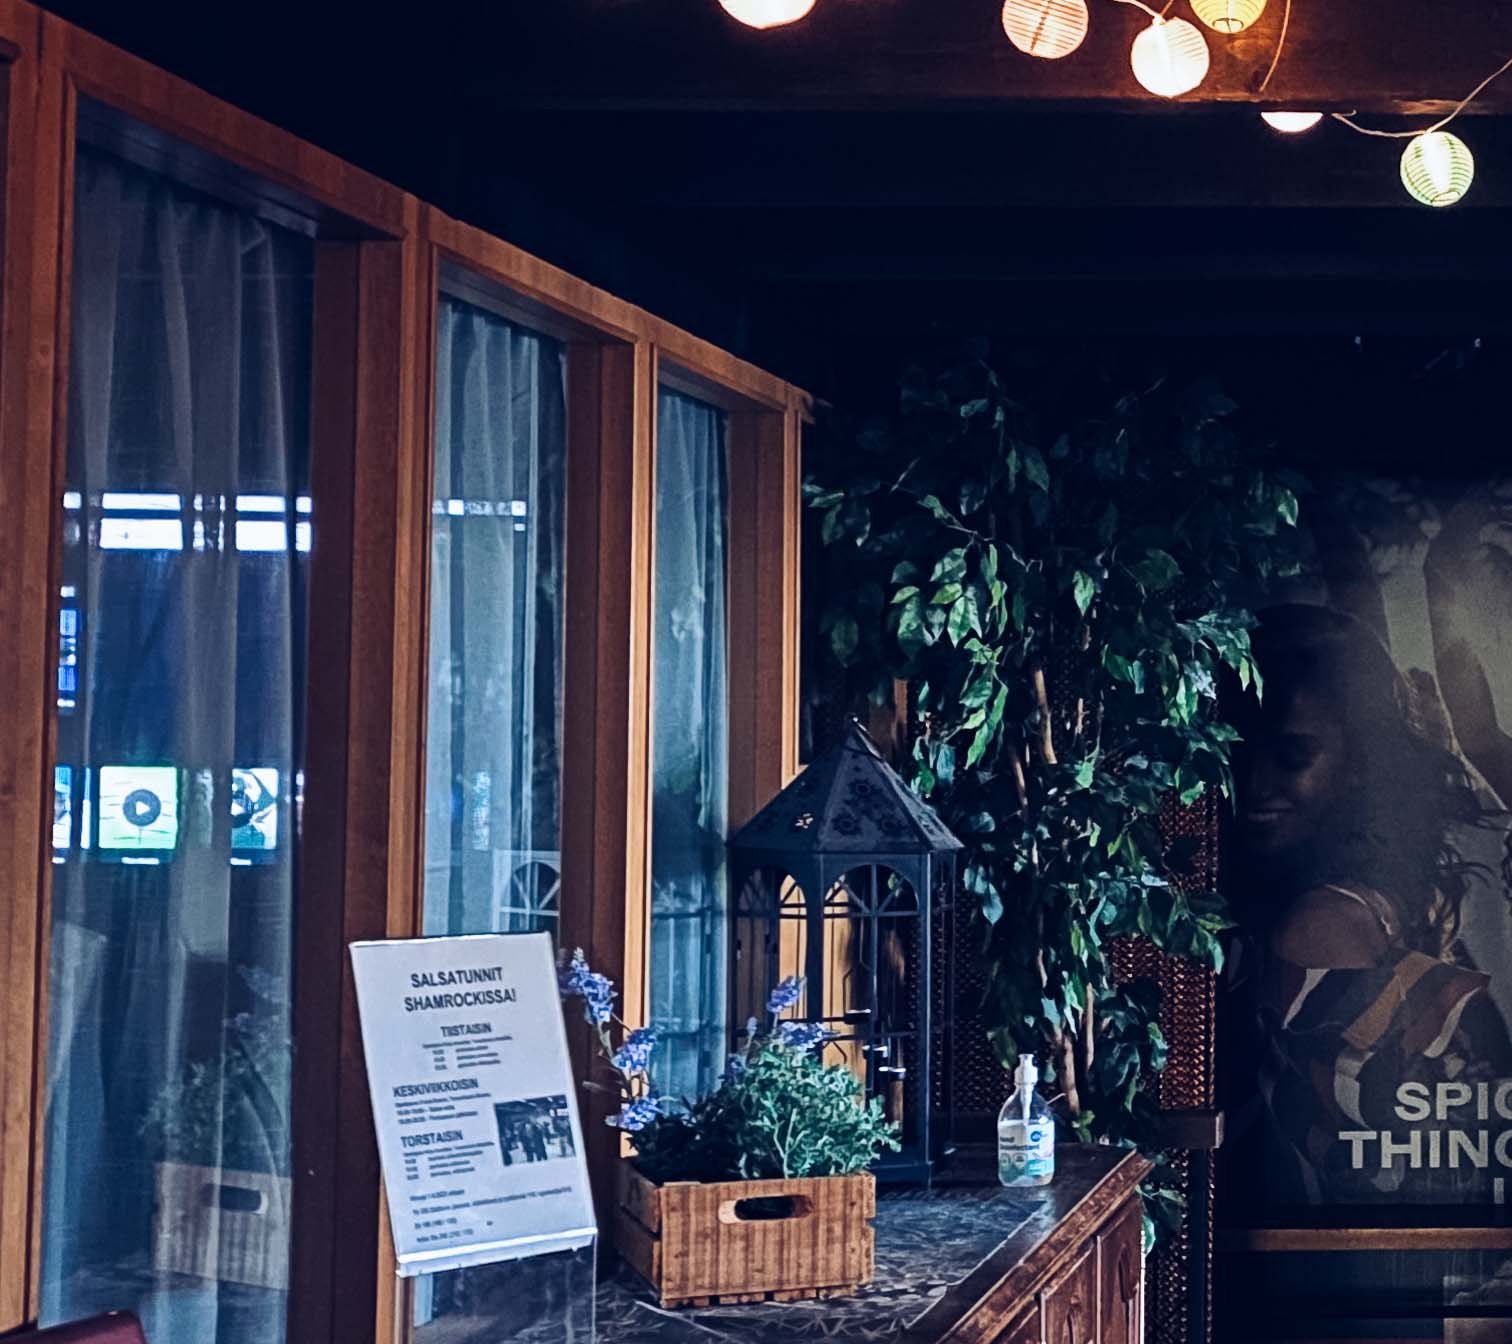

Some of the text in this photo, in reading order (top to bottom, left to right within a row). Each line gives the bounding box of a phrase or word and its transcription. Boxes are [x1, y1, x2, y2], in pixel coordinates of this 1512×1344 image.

[410, 966, 504, 989] SALSATUNNIT
[404, 988, 516, 1013] SHAMROCKISSA!
[440, 1022, 493, 1038] TIISTAISIN
[400, 1129, 464, 1149] TORSTAISIN
